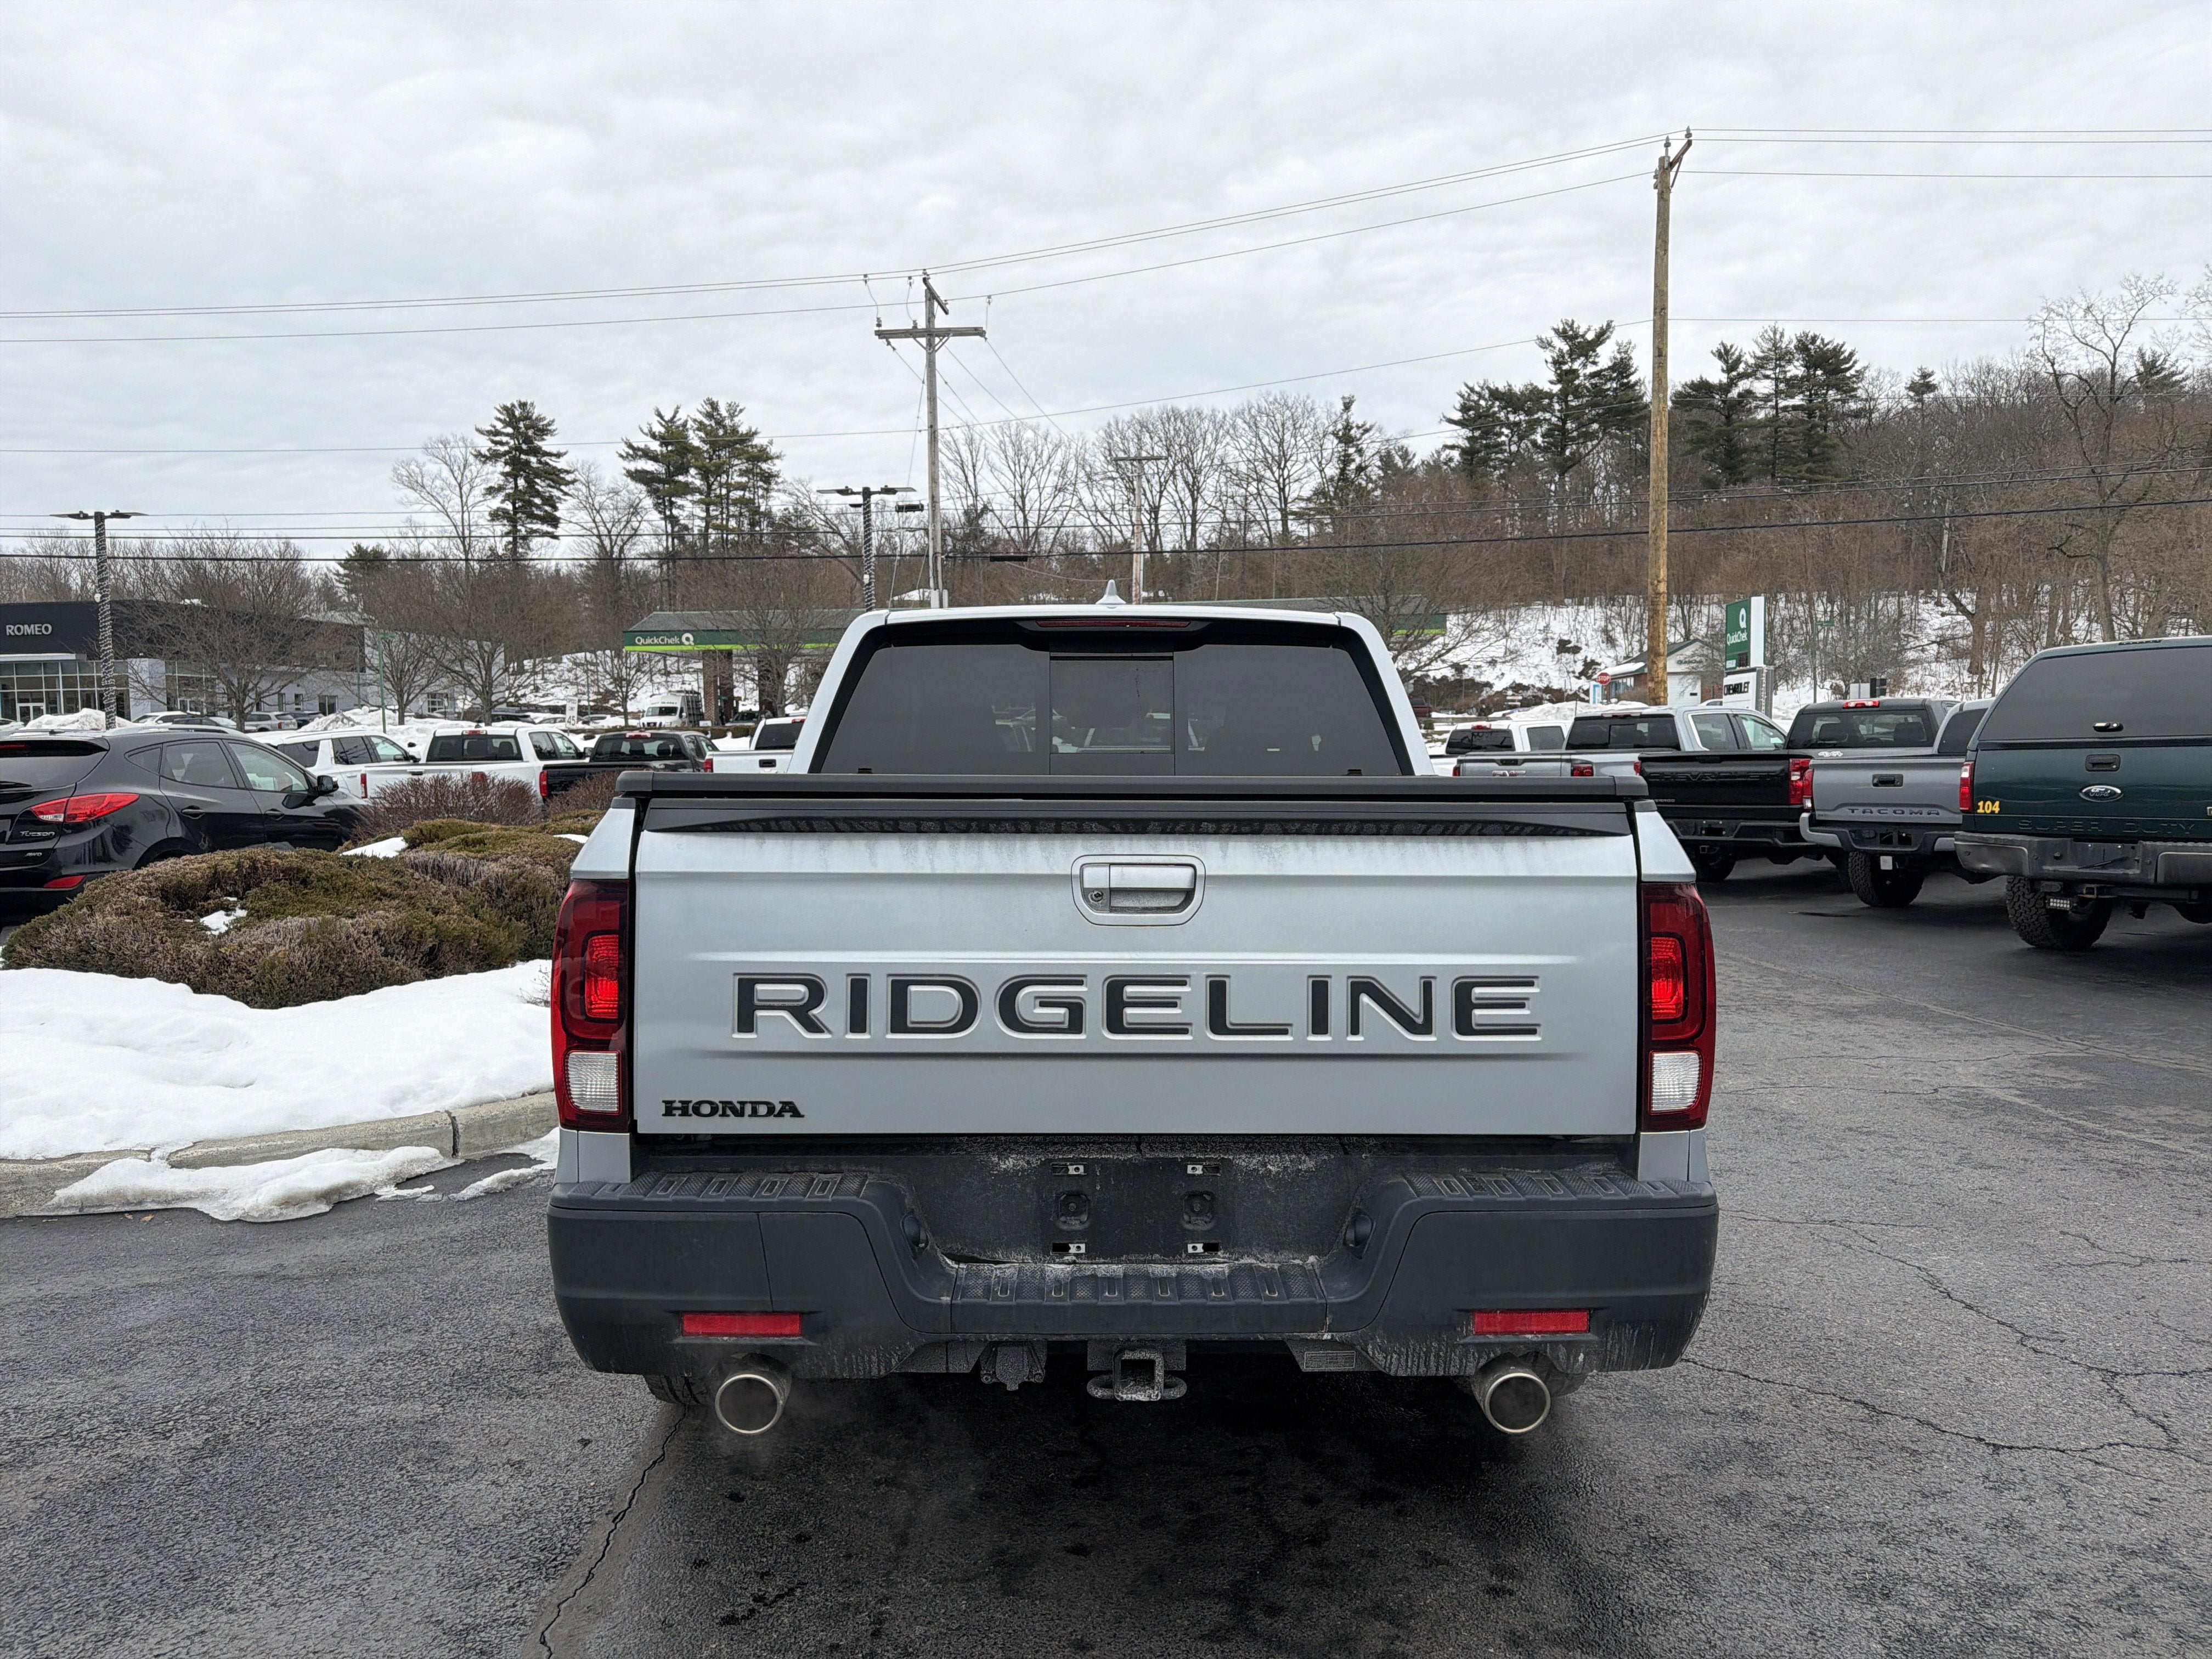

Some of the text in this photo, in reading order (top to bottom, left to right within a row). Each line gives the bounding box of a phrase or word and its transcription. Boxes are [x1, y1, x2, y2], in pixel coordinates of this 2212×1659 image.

[6, 624, 52, 635] ROMEO
[635, 636, 680, 645] QuickChek
[1726, 629, 1748, 645] QuickChek
[567, 715, 575, 726] 45
[1977, 800, 2000, 814] 104
[733, 973, 1541, 1039] RIDGELINE
[662, 1100, 805, 1118] HONDA
